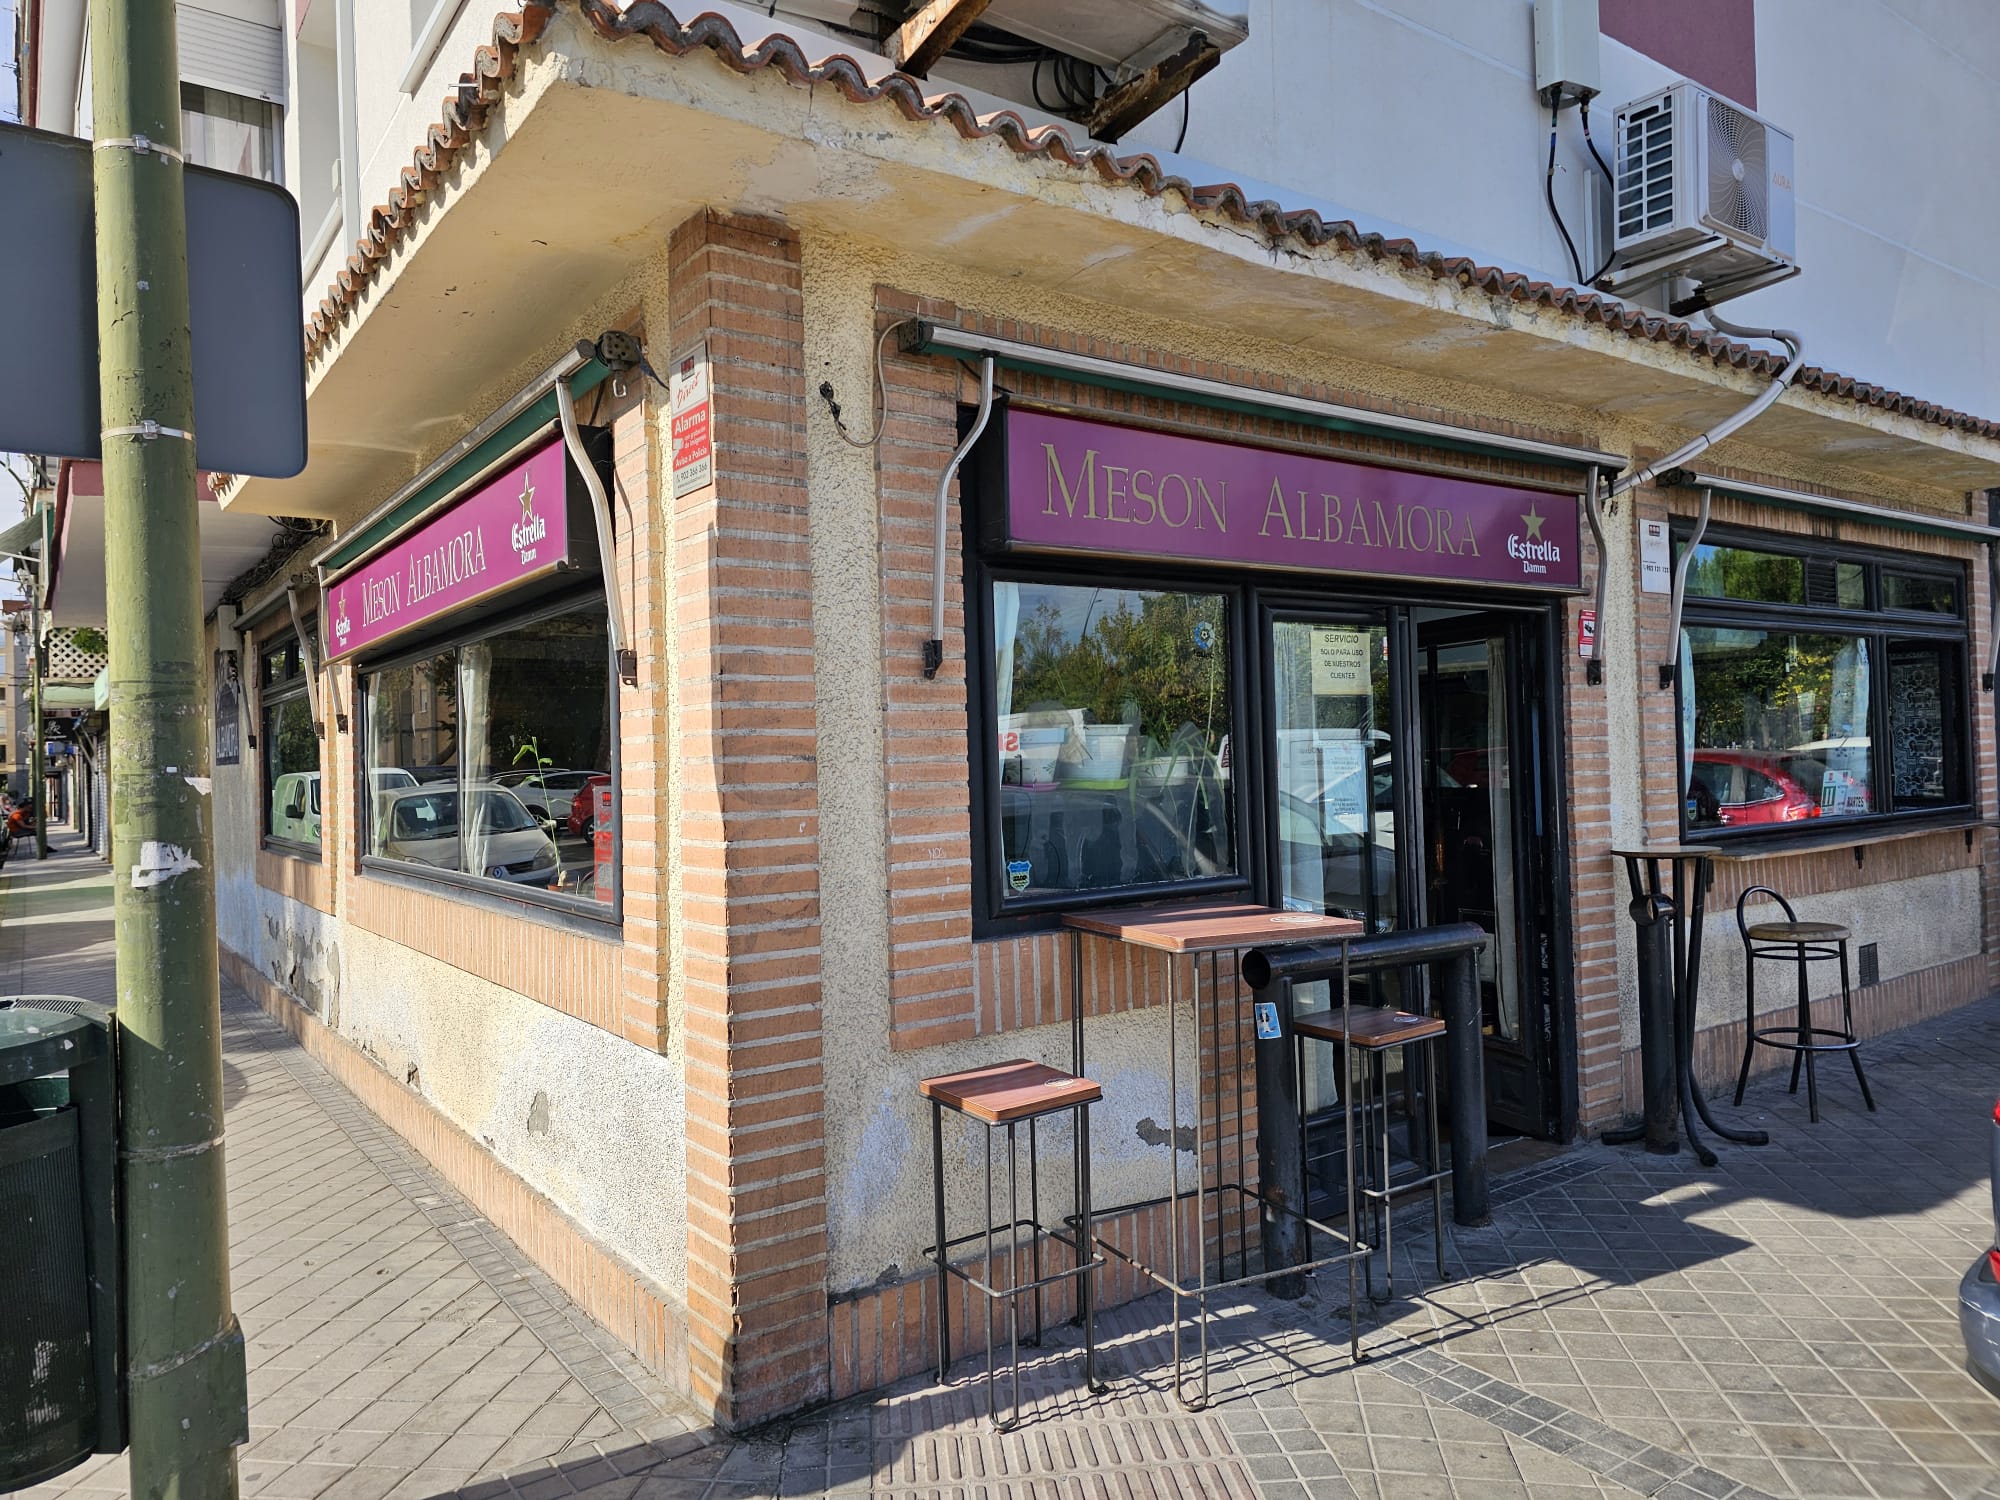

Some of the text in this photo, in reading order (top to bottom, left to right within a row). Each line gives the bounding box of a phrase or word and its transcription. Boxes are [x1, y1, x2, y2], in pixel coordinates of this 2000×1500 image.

[675, 409, 706, 435] Alarma
[675, 454, 688, 467] Aviso
[1040, 442, 1481, 557] MESON ALBAMORA
[512, 513, 546, 552] Estrella
[521, 548, 537, 565] Damm
[1507, 533, 1561, 562] Estrella
[362, 525, 486, 627] MESON ALBAMORA
[1523, 560, 1547, 574] Damm
[1324, 634, 1359, 644] SERVICIO
[1320, 648, 1335, 656] SOLO
